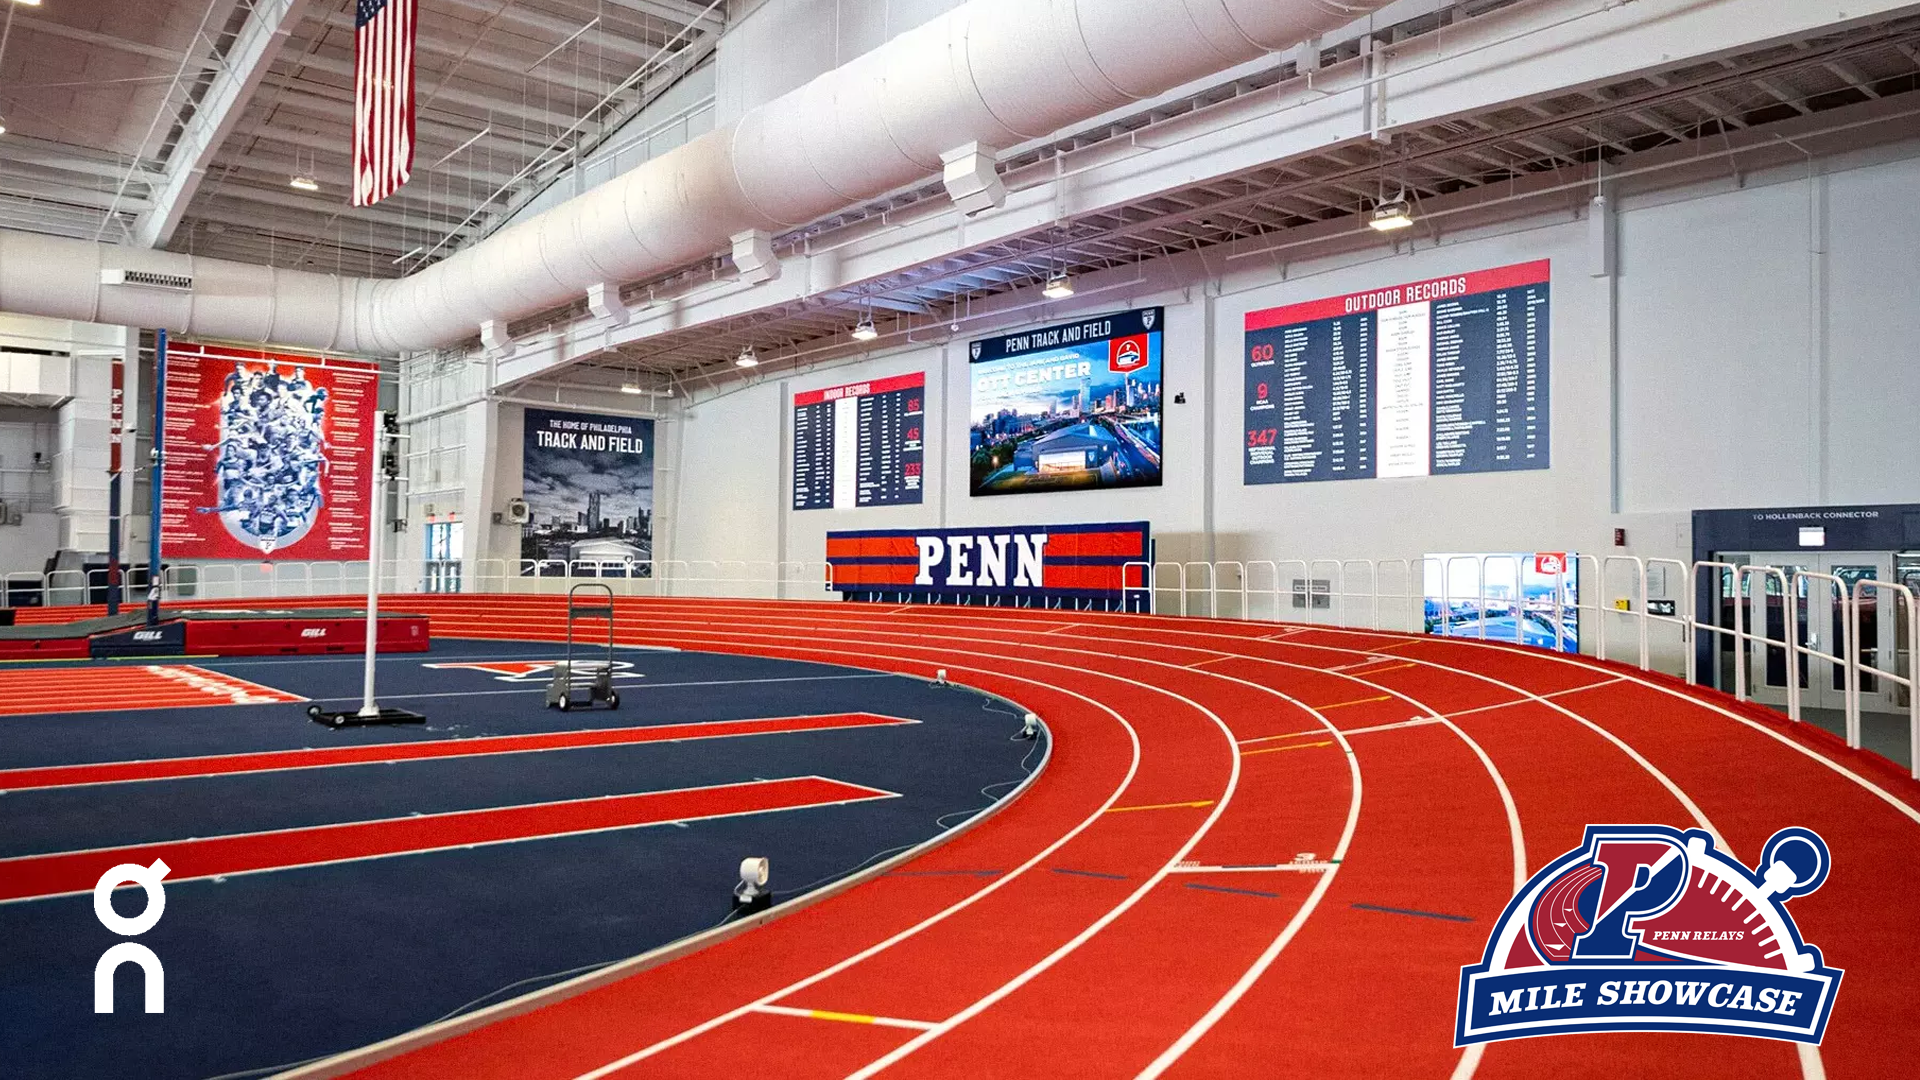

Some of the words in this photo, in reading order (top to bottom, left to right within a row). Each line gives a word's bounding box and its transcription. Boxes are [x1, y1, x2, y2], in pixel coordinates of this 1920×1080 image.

[1345, 289, 1400, 313] OUTDOOR
[1406, 277, 1466, 302] RECORDS
[1006, 337, 1029, 353] PENN
[1032, 330, 1060, 347] TRACK
[1062, 326, 1080, 342] AND
[1083, 320, 1111, 339] FIELD
[1060, 353, 1080, 361] DAVID
[1251, 343, 1274, 361] 60
[977, 374, 1011, 392] OTT
[1014, 361, 1091, 386] CENTER
[1257, 383, 1268, 399] 9
[111, 388, 123, 443] PENN
[549, 420, 562, 428] THE
[562, 421, 580, 430] HOME
[581, 422, 589, 430] OF
[589, 423, 632, 434] PHILADELPHIA
[537, 431, 577, 449] TRACK
[581, 434, 605, 452] AND
[608, 436, 643, 454] FIELD
[1248, 429, 1277, 446] 347
[1765, 512, 1822, 520] HOLLENBACK
[1822, 511, 1879, 519] CONNECTOR
[915, 533, 1048, 588] PENN
[133, 630, 163, 641] GILL
[300, 627, 327, 638] GILL
